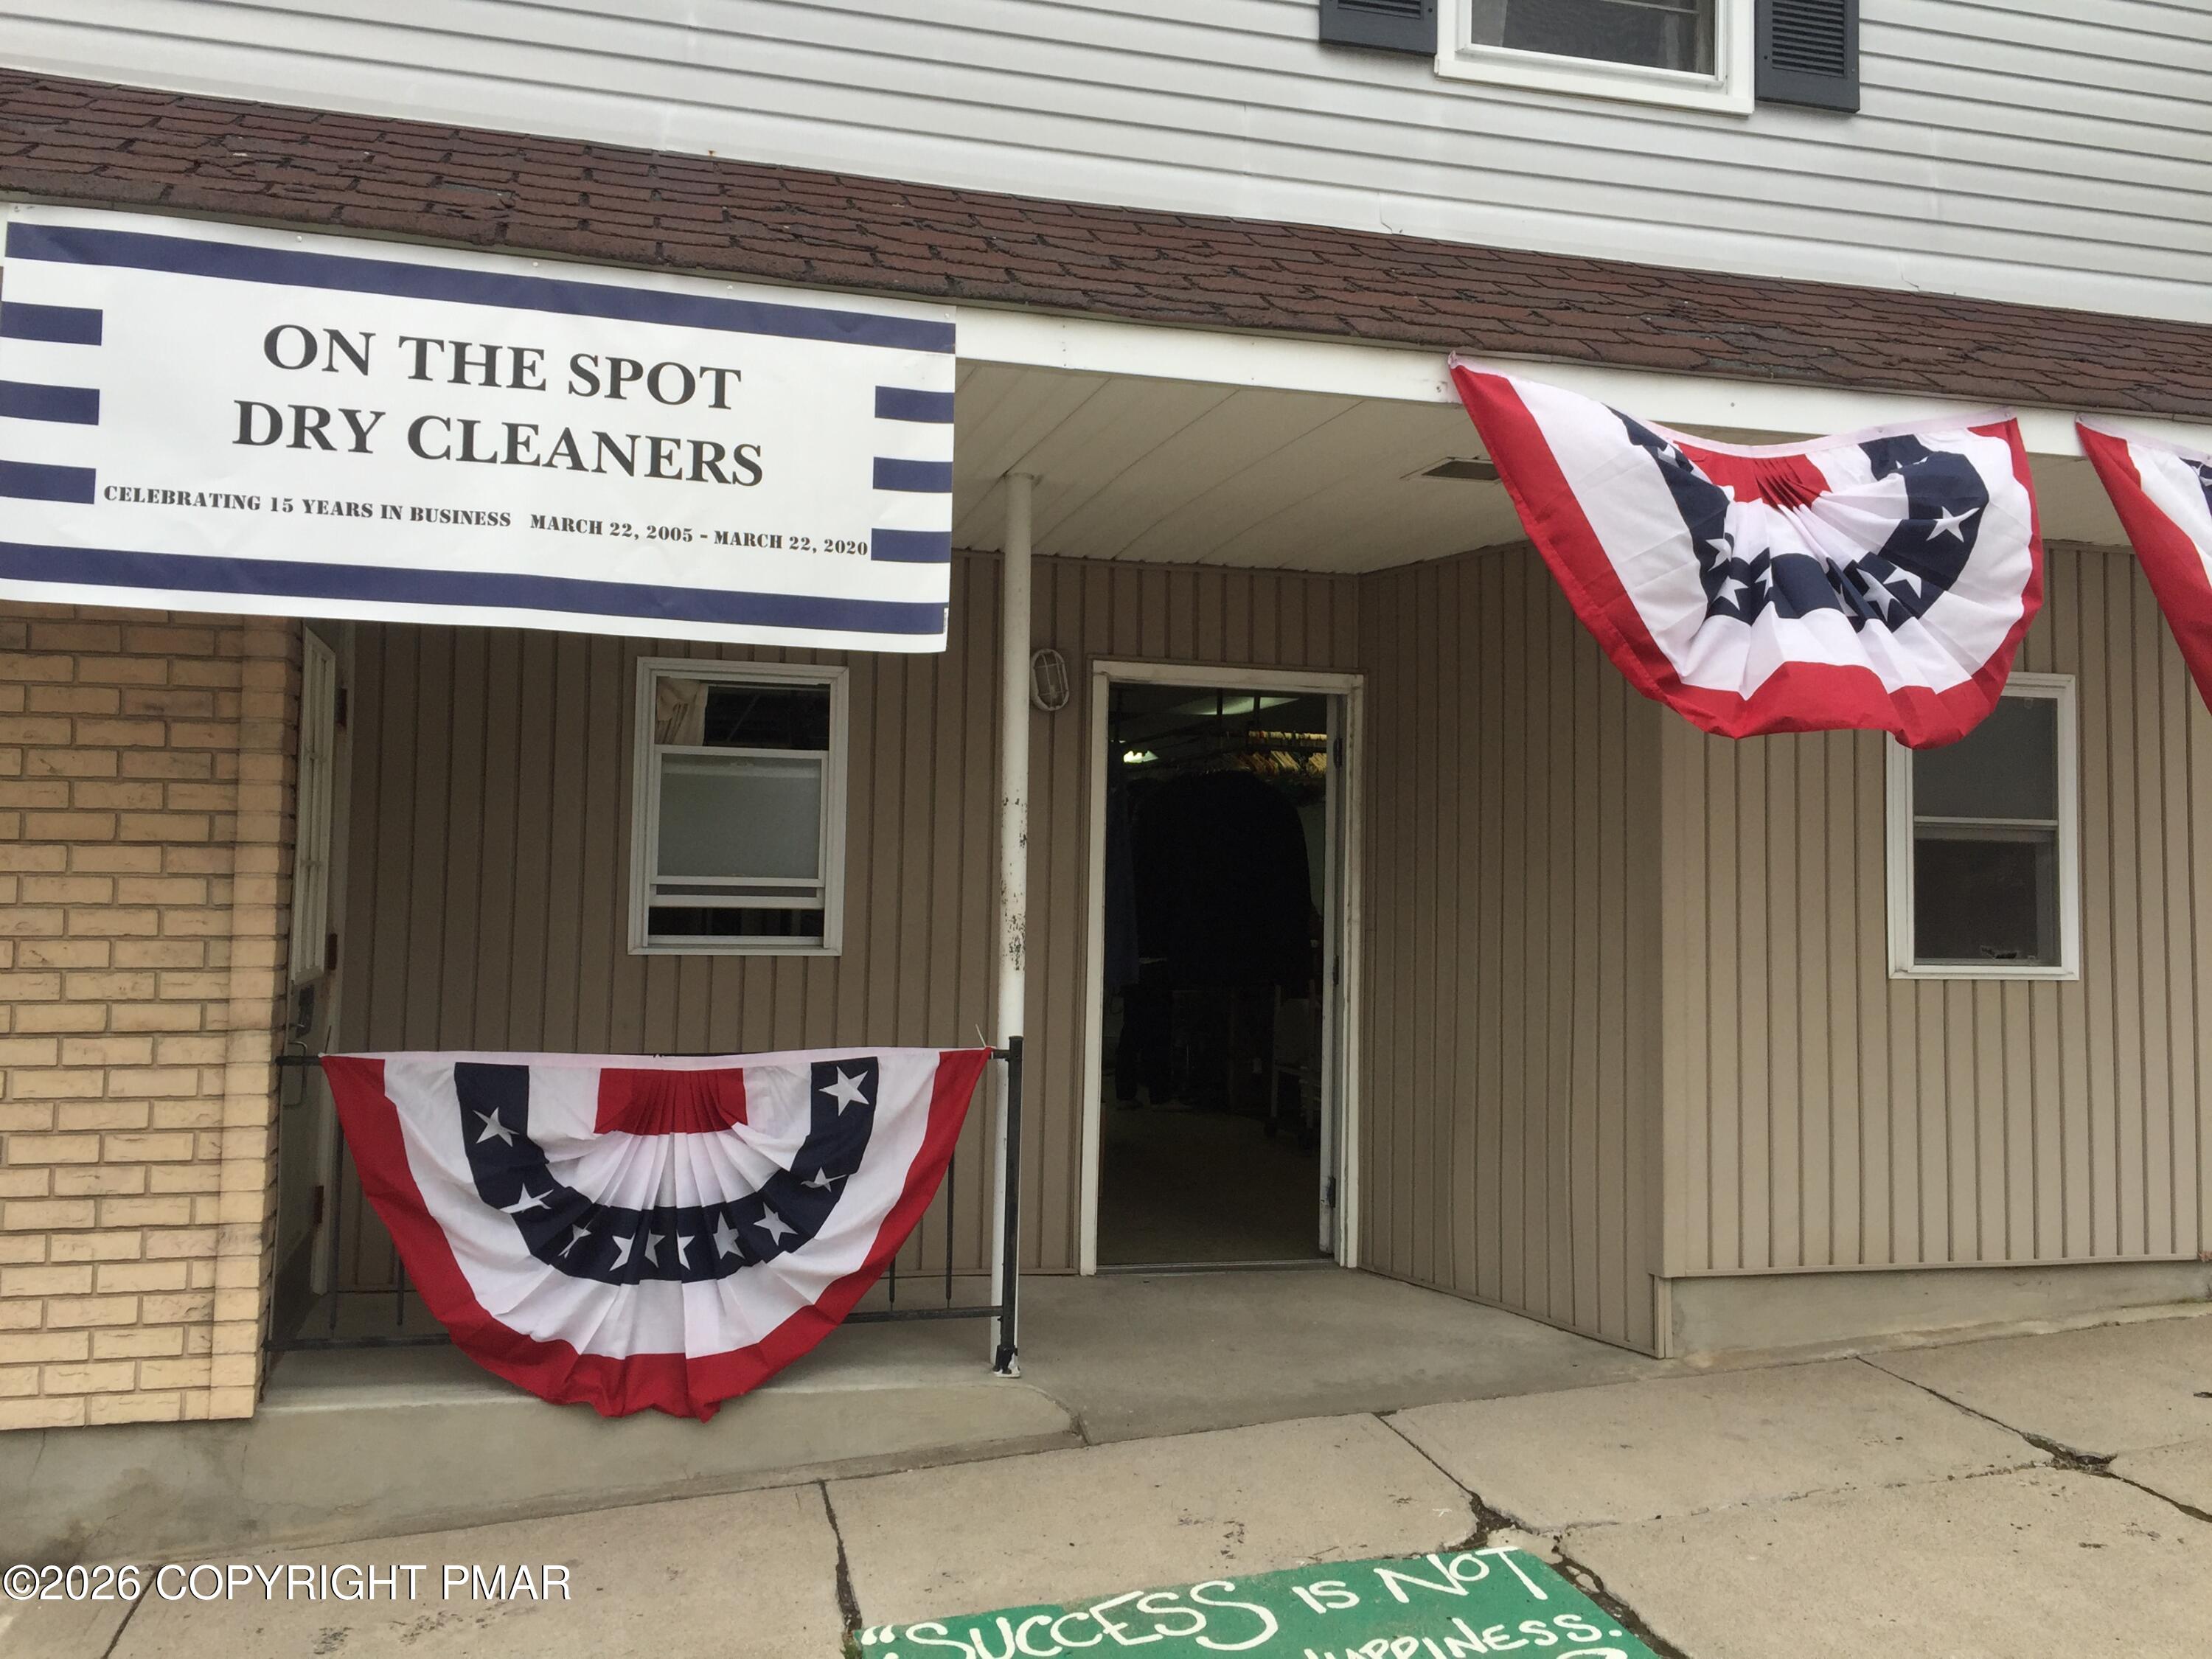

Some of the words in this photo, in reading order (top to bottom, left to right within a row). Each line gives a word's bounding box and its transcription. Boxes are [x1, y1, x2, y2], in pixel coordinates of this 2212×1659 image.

[264, 324, 375, 376] ON
[399, 336, 546, 392] THE
[568, 353, 741, 410] SPOT
[232, 400, 386, 454] DRY
[408, 415, 763, 487] CLEANERS
[103, 485, 261, 512] CELEBRATING
[270, 496, 293, 513] 15
[302, 499, 373, 518] YEARS
[380, 504, 403, 521] IN
[410, 506, 512, 527] BUSINESS
[530, 514, 603, 535] MARCH
[609, 521, 639, 540] 22,
[646, 524, 693, 543] 2005
[714, 530, 783, 549] MARCH
[788, 536, 818, 554] 22,
[824, 540, 869, 556] 2020
[1291, 1580, 1360, 1613] IS
